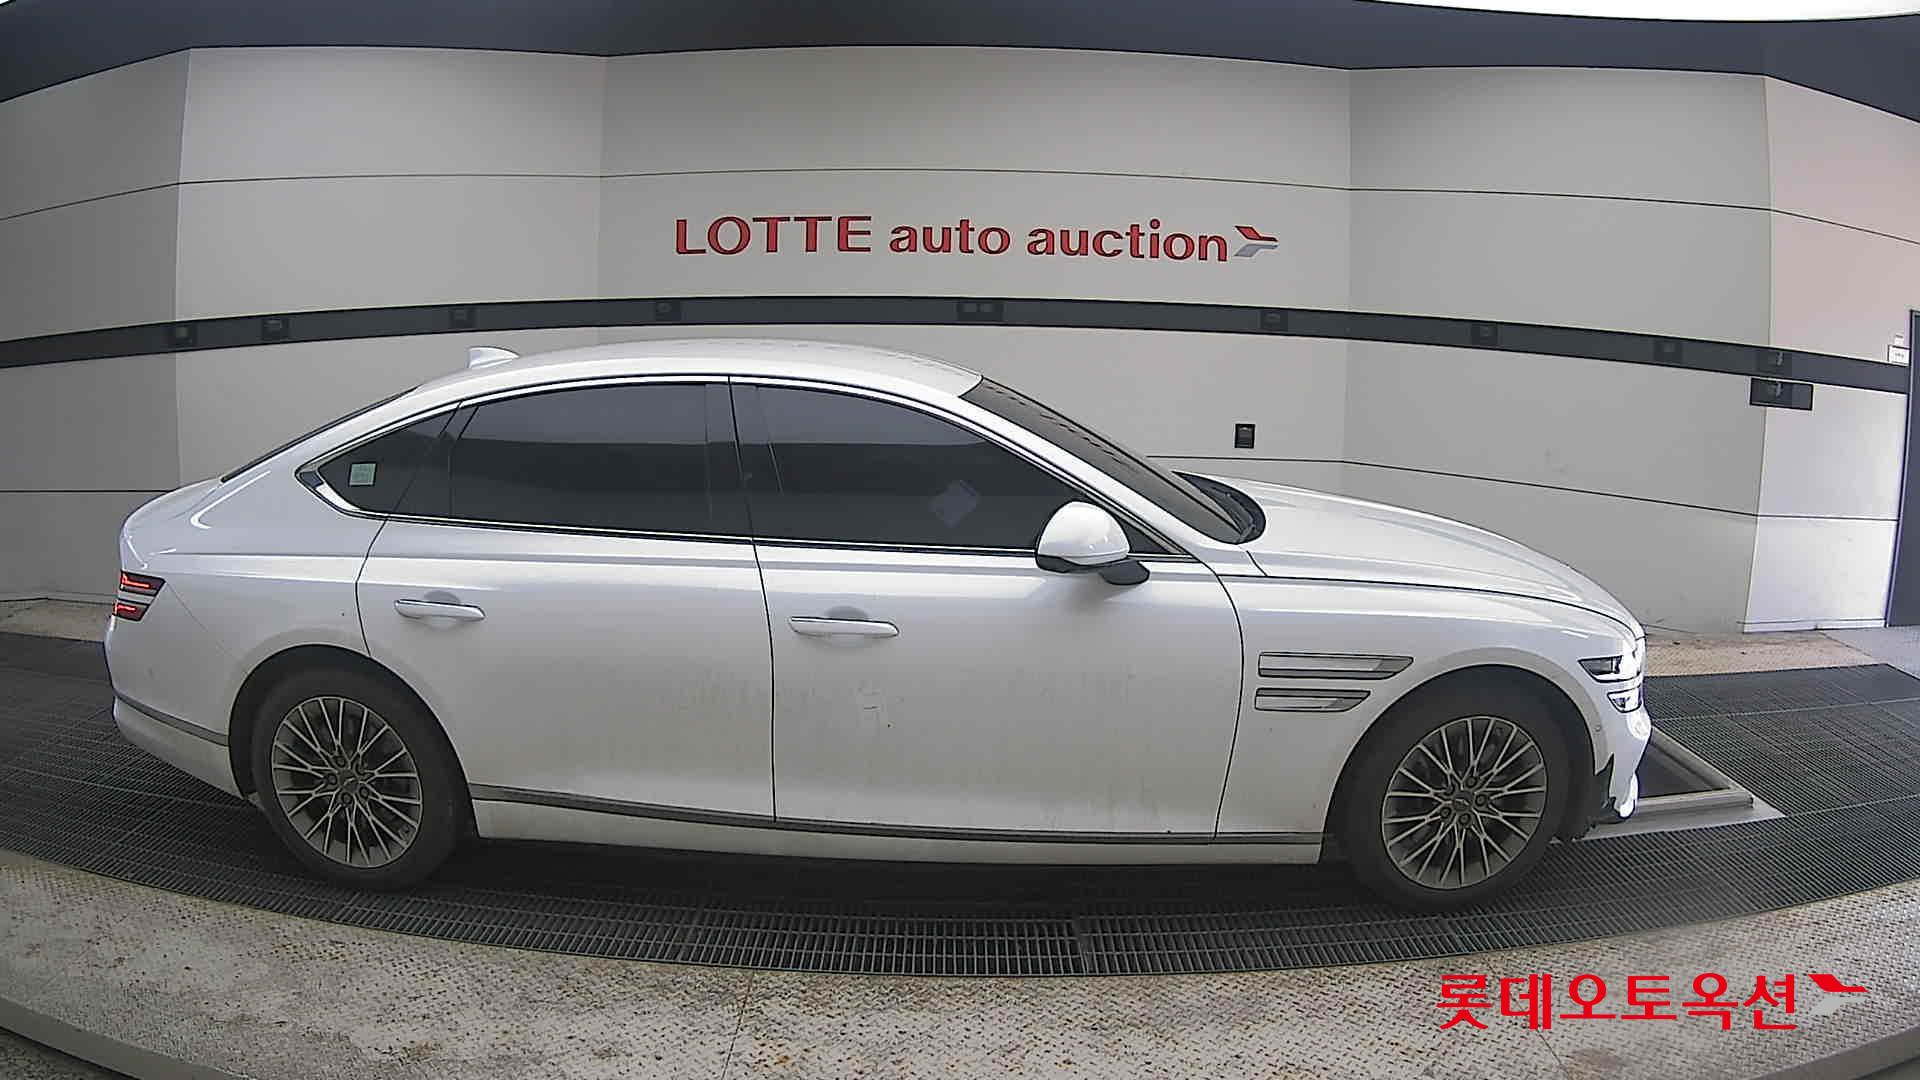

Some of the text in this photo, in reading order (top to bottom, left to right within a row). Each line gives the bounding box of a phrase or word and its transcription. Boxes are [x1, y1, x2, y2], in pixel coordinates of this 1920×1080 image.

[675, 215, 1228, 261] LOTTE auto auction
